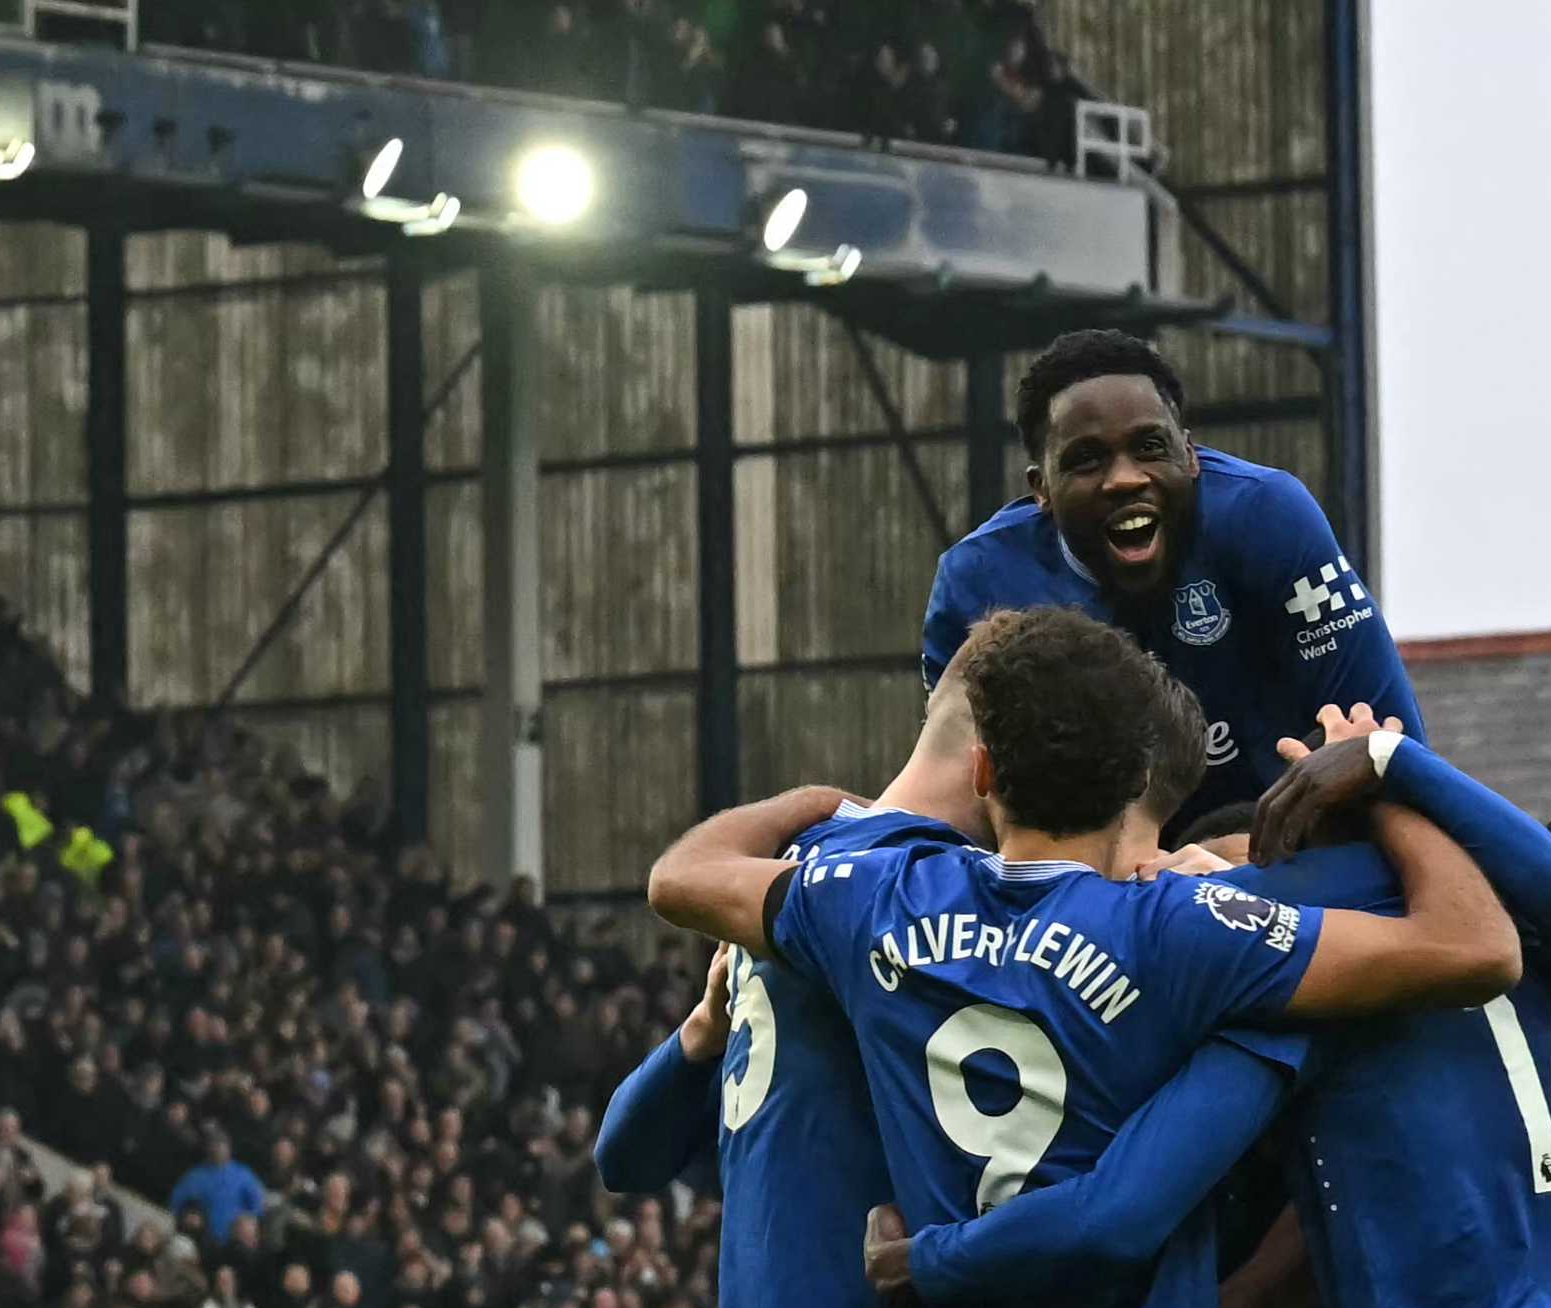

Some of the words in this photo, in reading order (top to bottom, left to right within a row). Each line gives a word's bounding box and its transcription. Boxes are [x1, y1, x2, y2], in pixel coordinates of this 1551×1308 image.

[1296, 605, 1373, 645] Christopher
[1300, 638, 1338, 661] Ward
[926, 1003, 1067, 1217] 9
